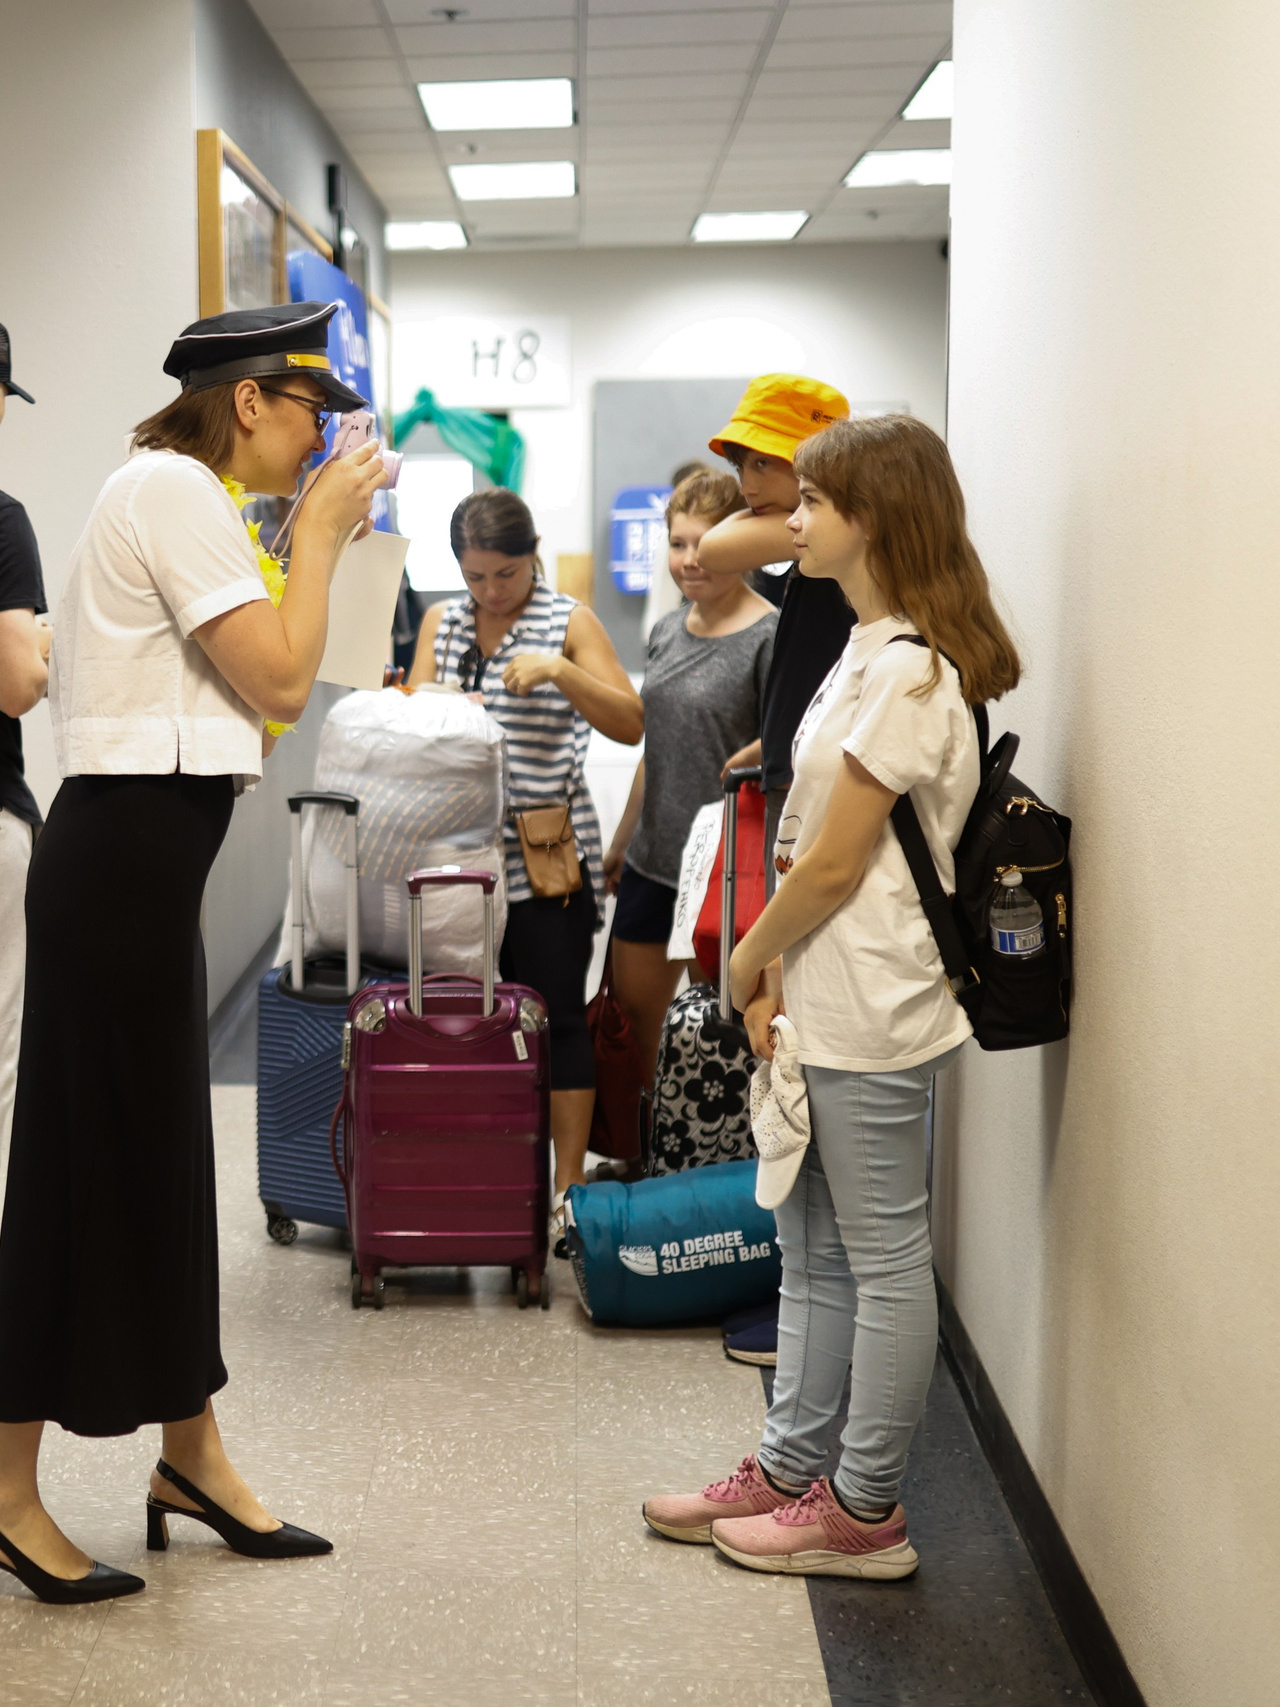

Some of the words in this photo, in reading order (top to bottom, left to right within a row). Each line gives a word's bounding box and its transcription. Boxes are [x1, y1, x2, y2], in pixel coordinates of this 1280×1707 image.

[660, 1242, 680, 1258] 40
[683, 1230, 744, 1255] DEGREE
[662, 1248, 735, 1275] SLEEPING
[738, 1242, 771, 1262] BAG
